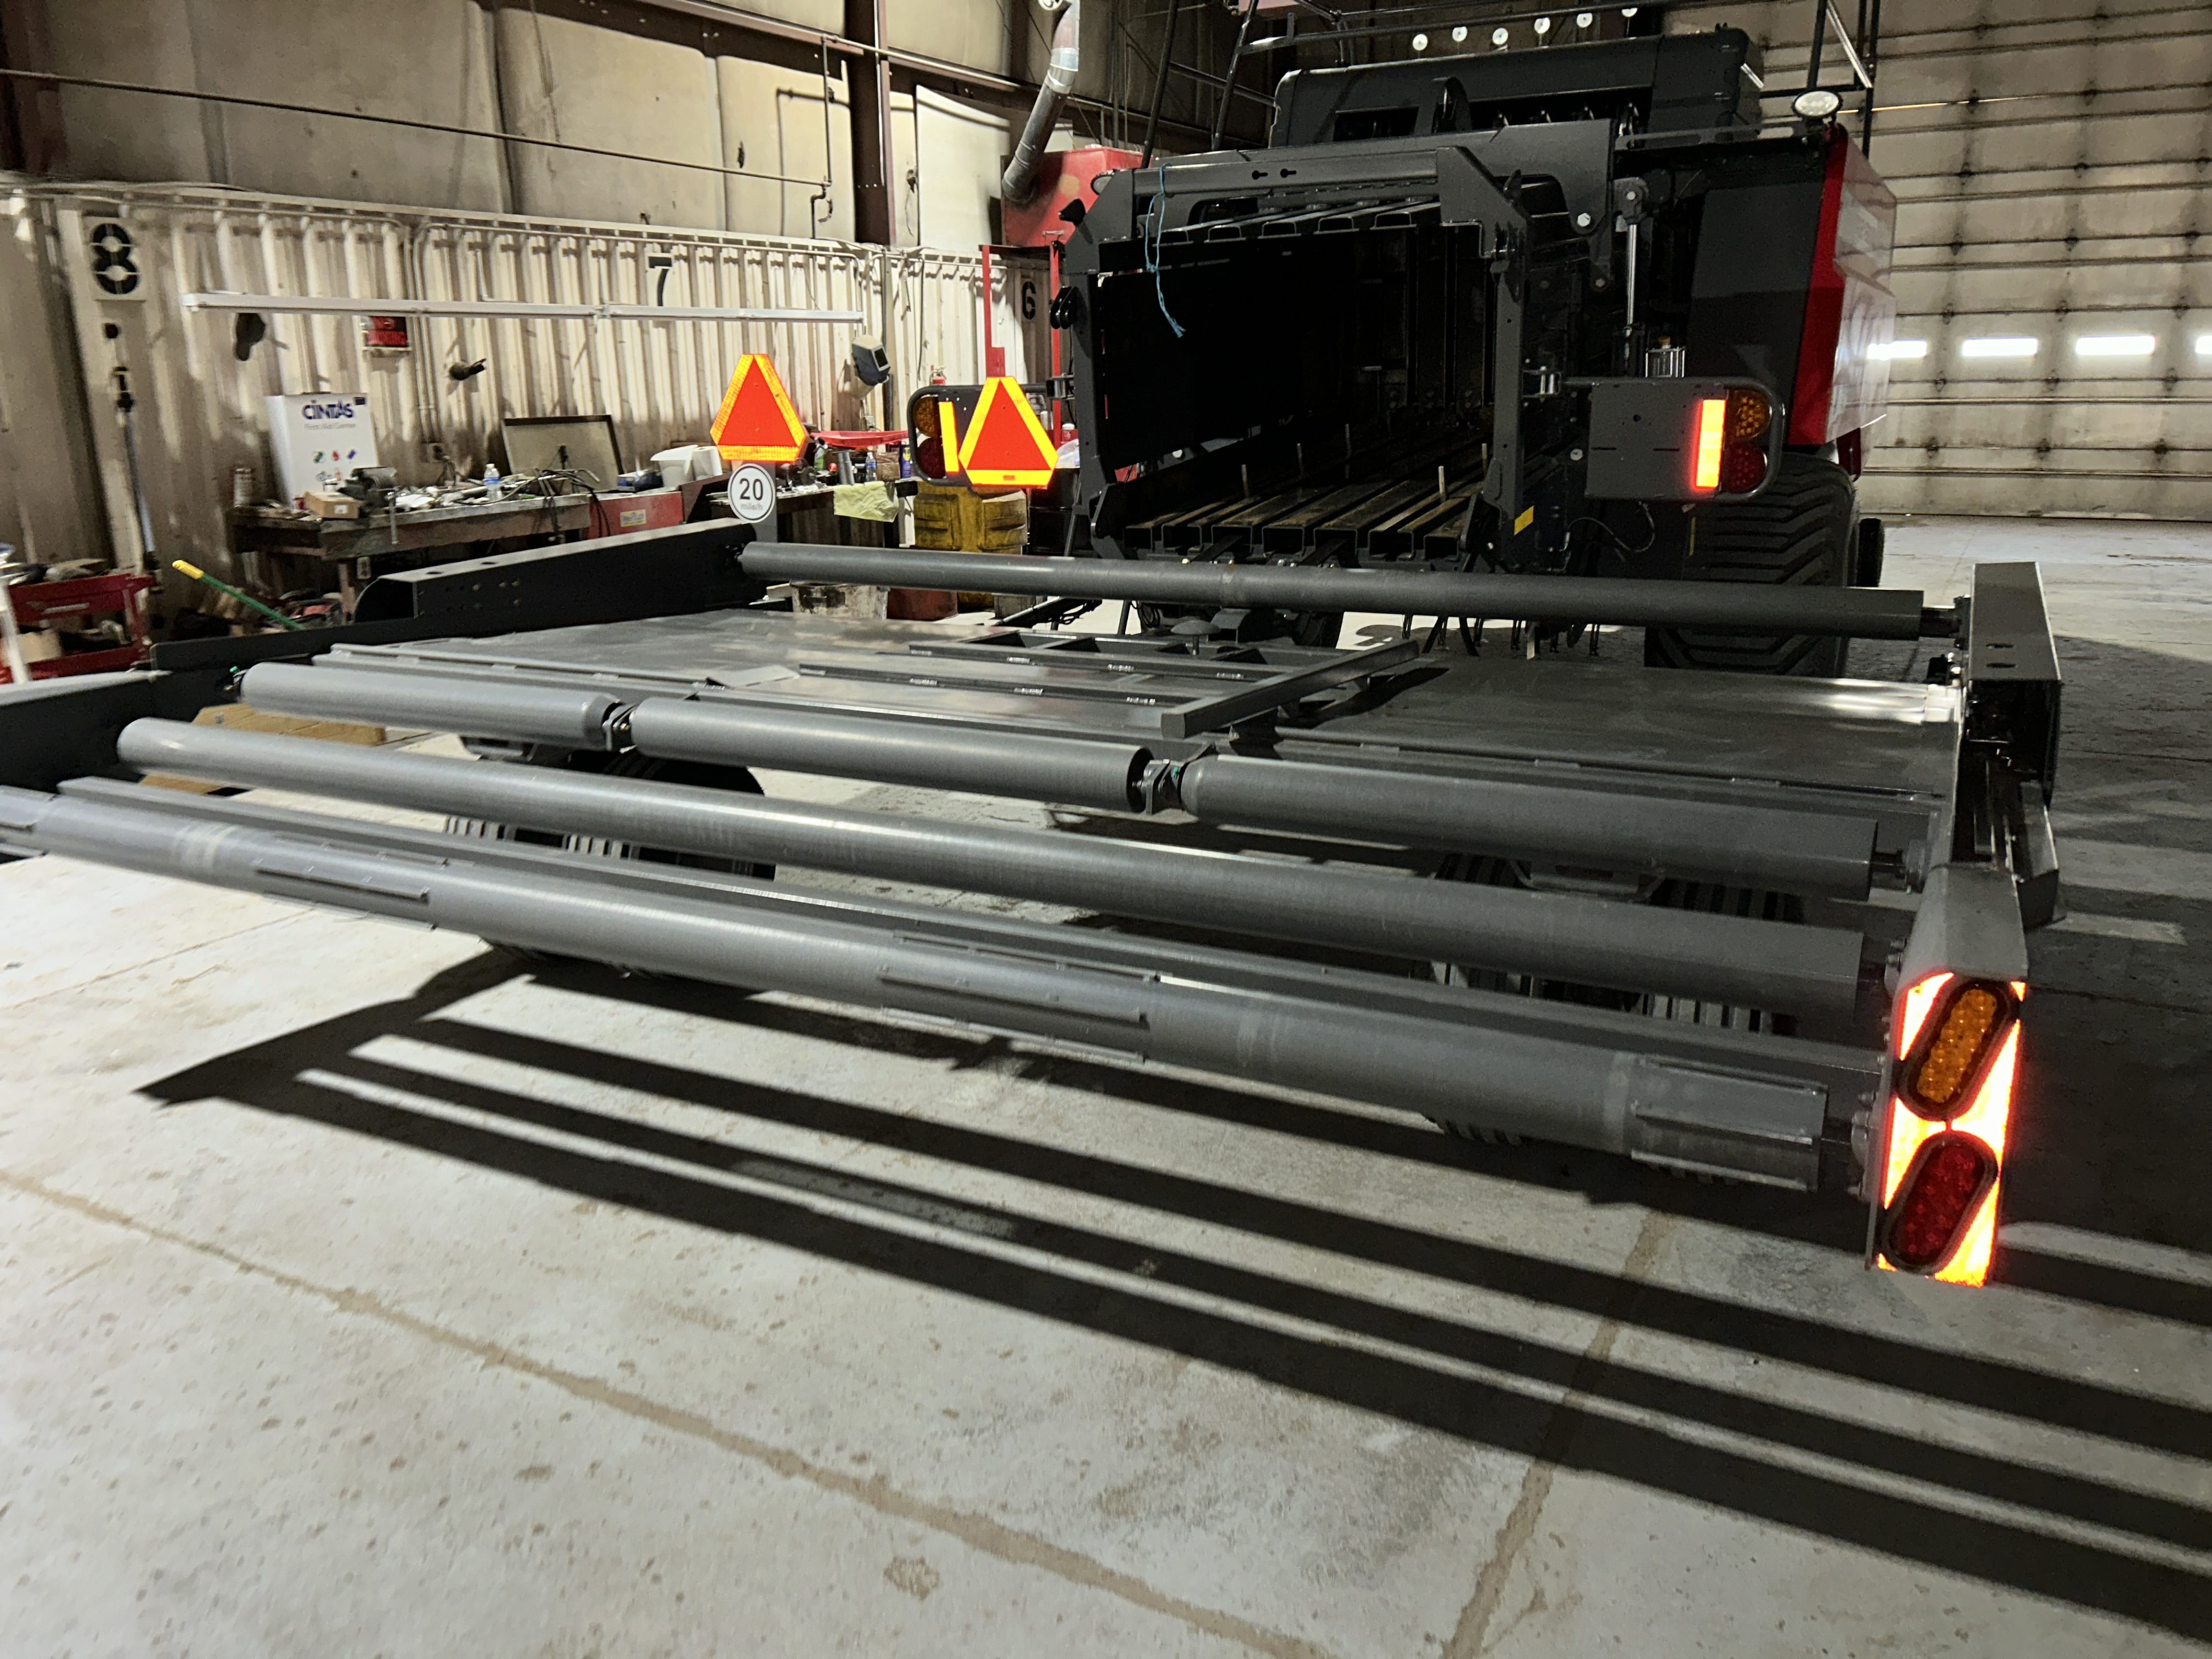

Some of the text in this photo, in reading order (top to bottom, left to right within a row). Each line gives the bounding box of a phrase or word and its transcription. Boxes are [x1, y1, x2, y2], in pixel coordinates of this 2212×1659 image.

[92, 223, 140, 295] 8
[649, 256, 672, 307] 7
[1022, 281, 1036, 320] 6
[739, 478, 763, 500] 20
